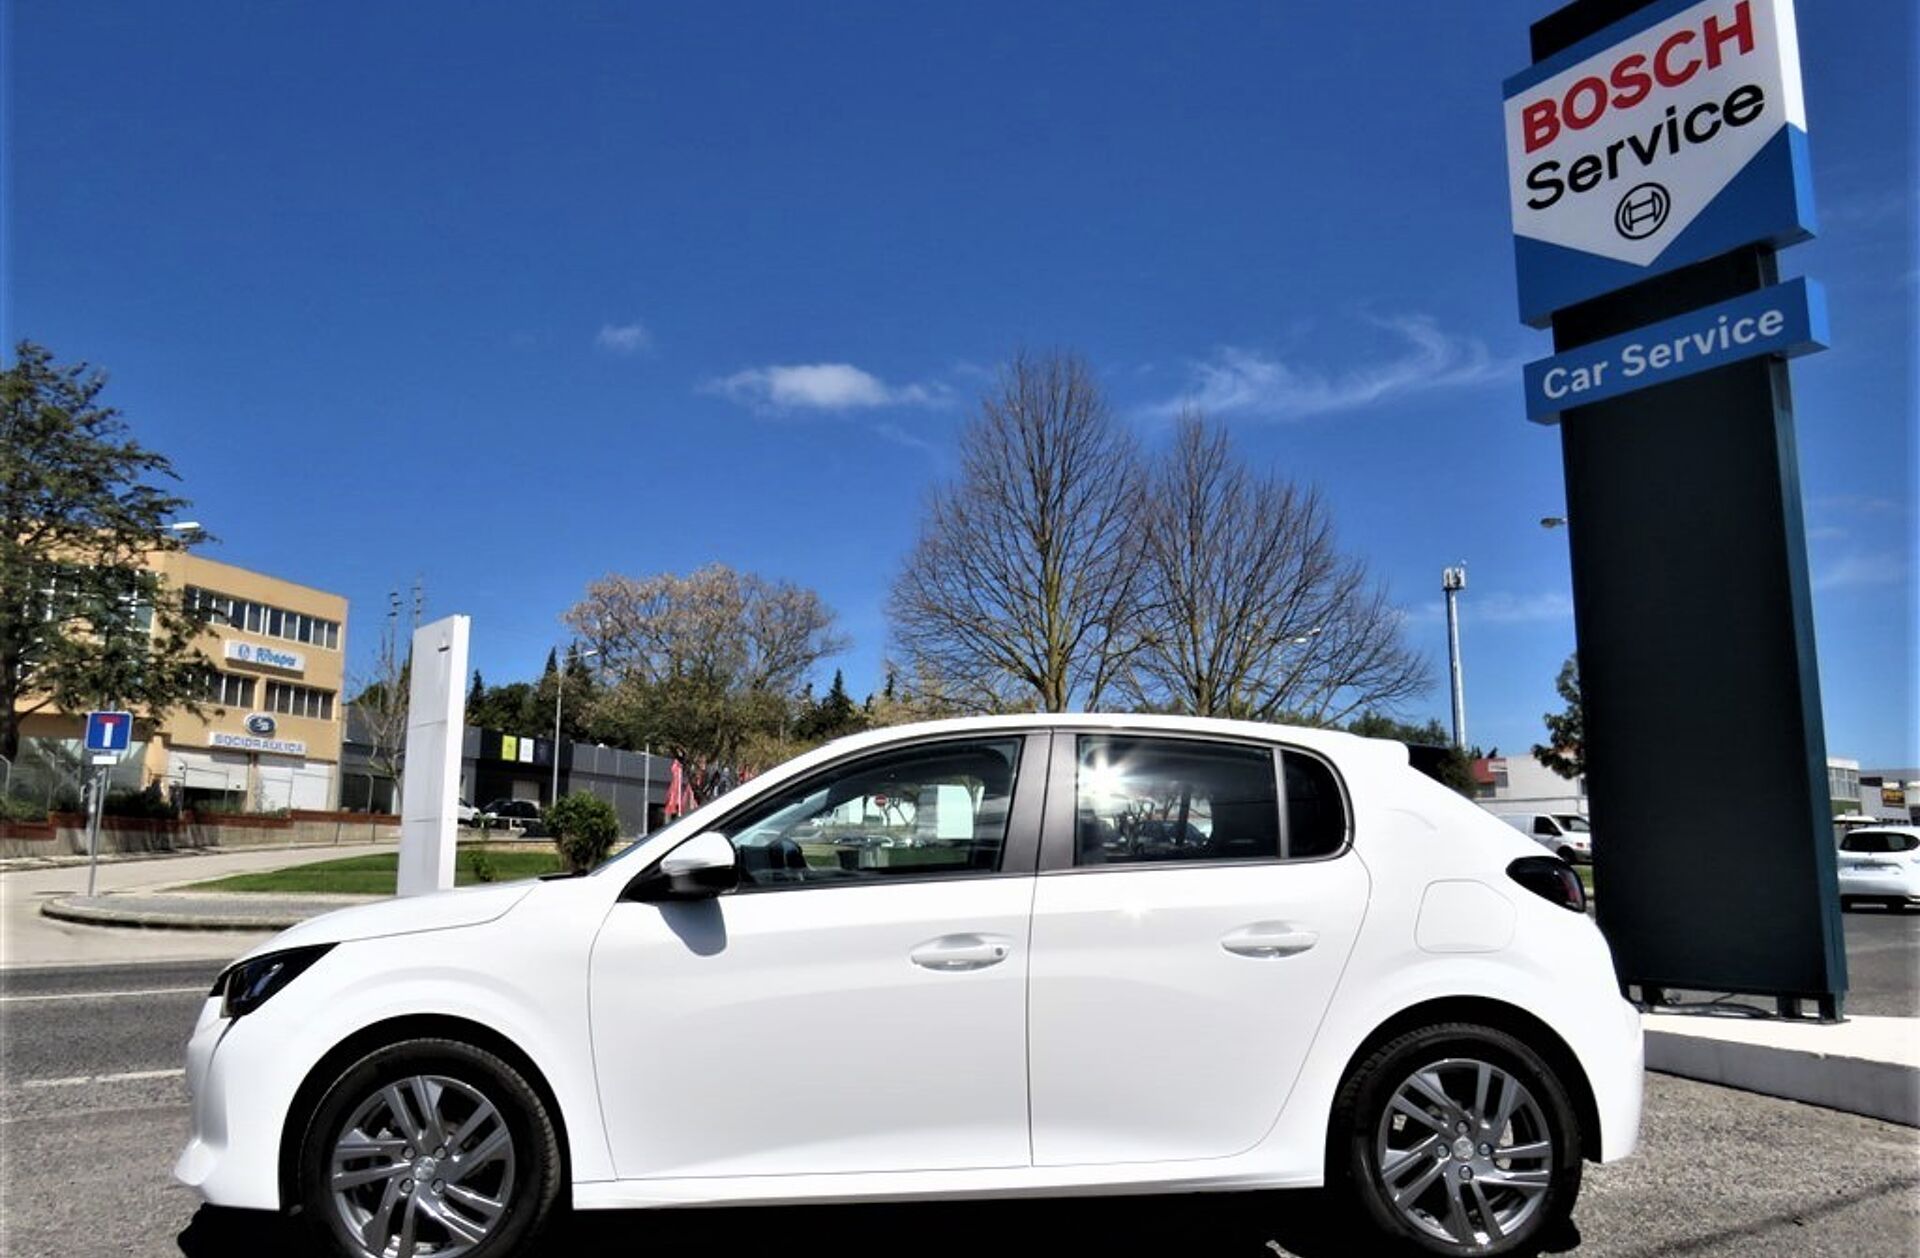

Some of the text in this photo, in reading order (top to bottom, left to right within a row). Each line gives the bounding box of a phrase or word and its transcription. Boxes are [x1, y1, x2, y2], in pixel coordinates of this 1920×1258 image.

[1522, 0, 1755, 154] BOSCH
[1526, 84, 1765, 210] Service
[1543, 309, 1784, 399] Car Service
